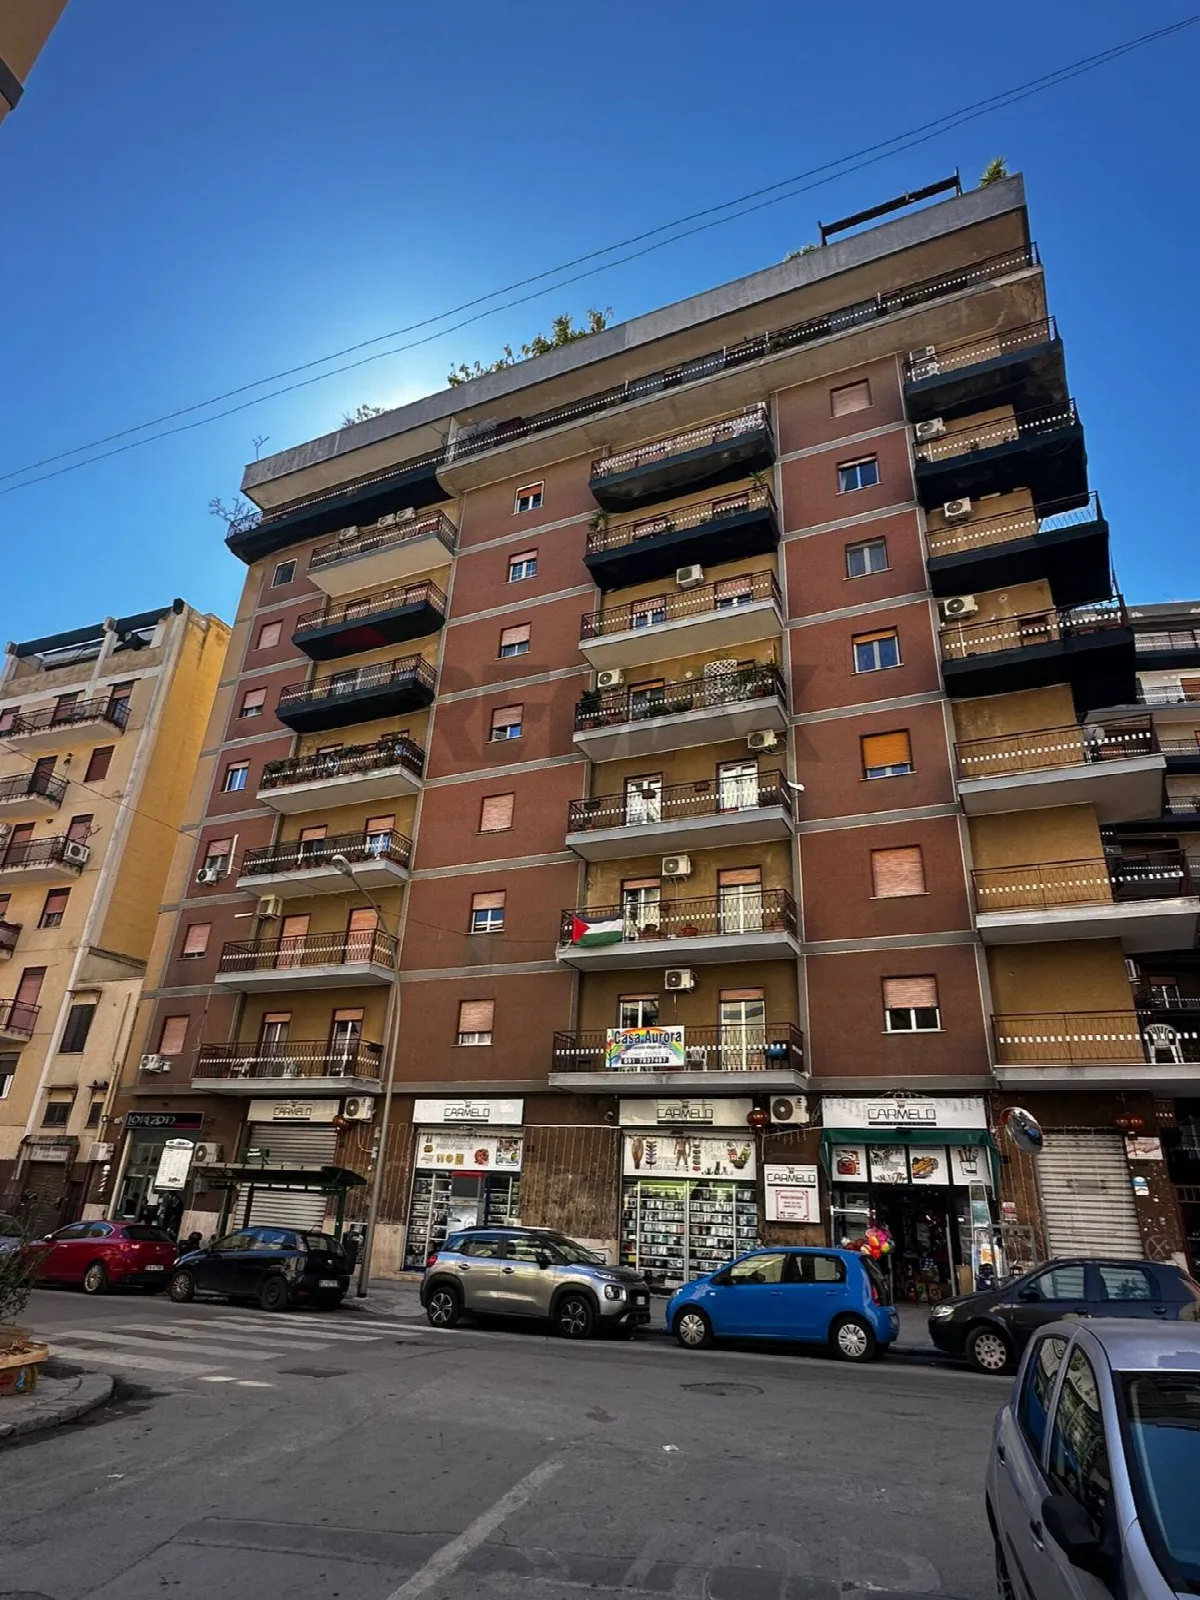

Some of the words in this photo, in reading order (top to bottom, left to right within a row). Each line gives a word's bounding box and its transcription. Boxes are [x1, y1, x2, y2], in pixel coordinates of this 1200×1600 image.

[614, 1030, 641, 1045] Casa
[645, 1029, 682, 1044] Aurora
[273, 1107, 312, 1116] CARMELO
[444, 1108, 490, 1117] CARMELO
[657, 1108, 713, 1118] CARMELO
[868, 1108, 936, 1120] CARMELO
[767, 1173, 816, 1183] CARMELO
